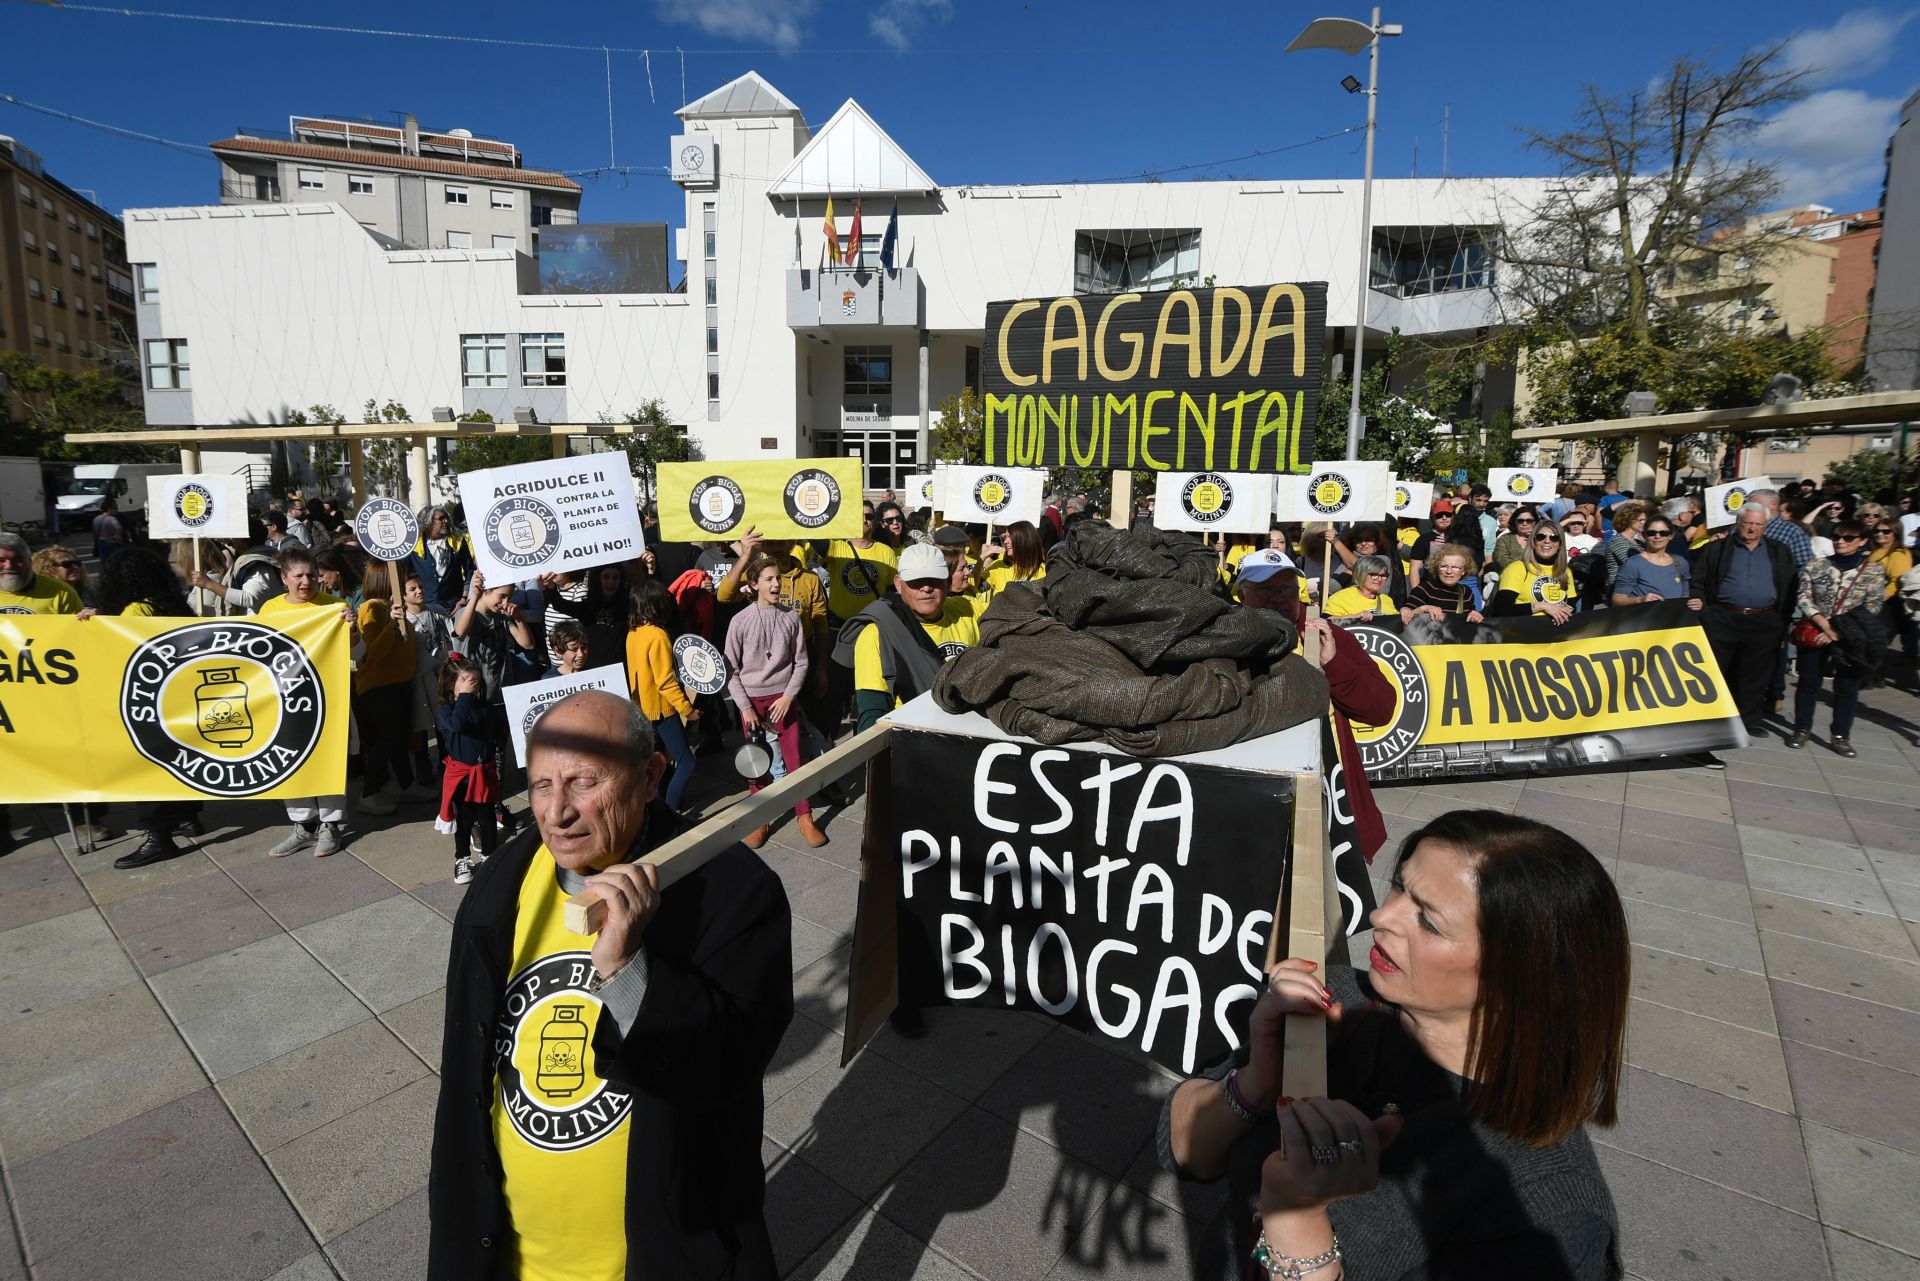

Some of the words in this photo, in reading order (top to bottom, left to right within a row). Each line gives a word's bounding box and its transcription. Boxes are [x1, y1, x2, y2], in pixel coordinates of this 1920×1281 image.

[998, 283, 1306, 386] CAGADA
[985, 390, 1313, 475] MONUMENTAL
[493, 473, 589, 498] AGRIDULCE
[594, 471, 605, 483] II
[691, 482, 707, 504] STOP
[786, 475, 803, 496] STOP
[1184, 478, 1199, 500] STOP
[1310, 477, 1322, 496] STOP
[556, 491, 599, 505] CONTRA
[601, 489, 615, 497] LA
[978, 502, 1006, 512] MOLINA
[1315, 501, 1345, 512] MOLINA
[359, 506, 373, 534] STOP
[563, 505, 604, 518] PLANTA
[606, 502, 620, 511] DE
[794, 512, 829, 526] MOLINA
[1189, 508, 1226, 521] MOLINA
[487, 508, 503, 542] STOP
[569, 518, 608, 531] BIOGAS
[700, 518, 734, 531] MOLINA
[370, 541, 413, 558] MOLINA
[502, 543, 556, 565] MOLINA
[563, 541, 599, 560] AQUÍ
[602, 537, 632, 552] NO!!
[675, 637, 693, 656] STOP
[131, 643, 178, 723] STOP
[209, 631, 312, 714] BIOGÁS
[678, 666, 716, 692] MOLINA
[1441, 660, 1474, 726] A
[1480, 641, 1719, 724] NOSOTROS
[524, 710, 536, 734] STOP
[1361, 727, 1415, 765] LINA
[171, 745, 299, 788] MOLINA
[973, 742, 1194, 866] ESTA
[901, 829, 1174, 943] PLANTA
[1199, 893, 1273, 982] DE
[509, 1089, 629, 1140] MOLINA
